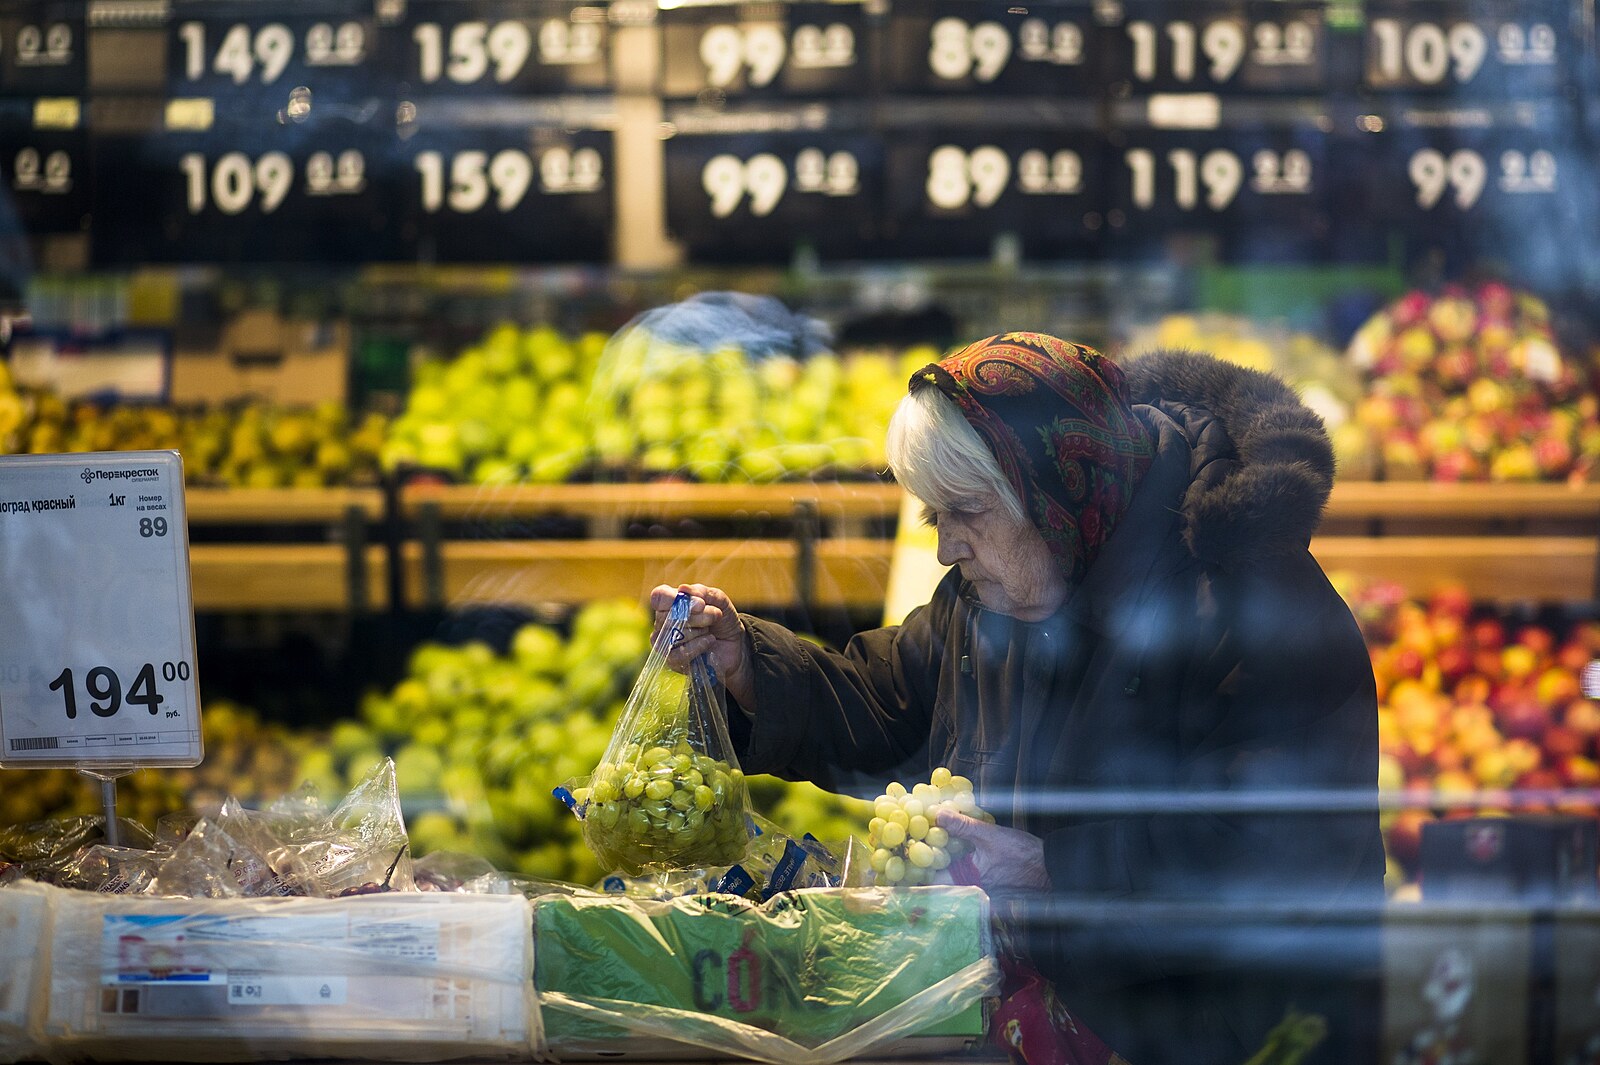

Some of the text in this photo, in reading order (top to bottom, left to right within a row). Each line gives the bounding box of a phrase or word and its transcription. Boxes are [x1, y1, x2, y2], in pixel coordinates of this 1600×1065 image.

[178, 21, 295, 84] 149
[413, 22, 531, 83] 159
[700, 24, 786, 87] 99
[928, 17, 1010, 82] 89
[1126, 21, 1245, 82] 119
[1372, 20, 1487, 84] 109
[180, 151, 293, 214] 109
[415, 150, 532, 213] 159
[703, 153, 787, 217] 99
[926, 145, 1010, 208] 89
[1124, 148, 1243, 210] 119
[1408, 149, 1487, 210] 99
[0, 495, 76, 515] оград красный
[96, 468, 159, 481] Перекресток
[109, 493, 126, 507] 1кг
[139, 516, 168, 538] 89
[146, 503, 167, 511] весах
[49, 661, 190, 720] 194 00
[165, 709, 181, 719] руб.
